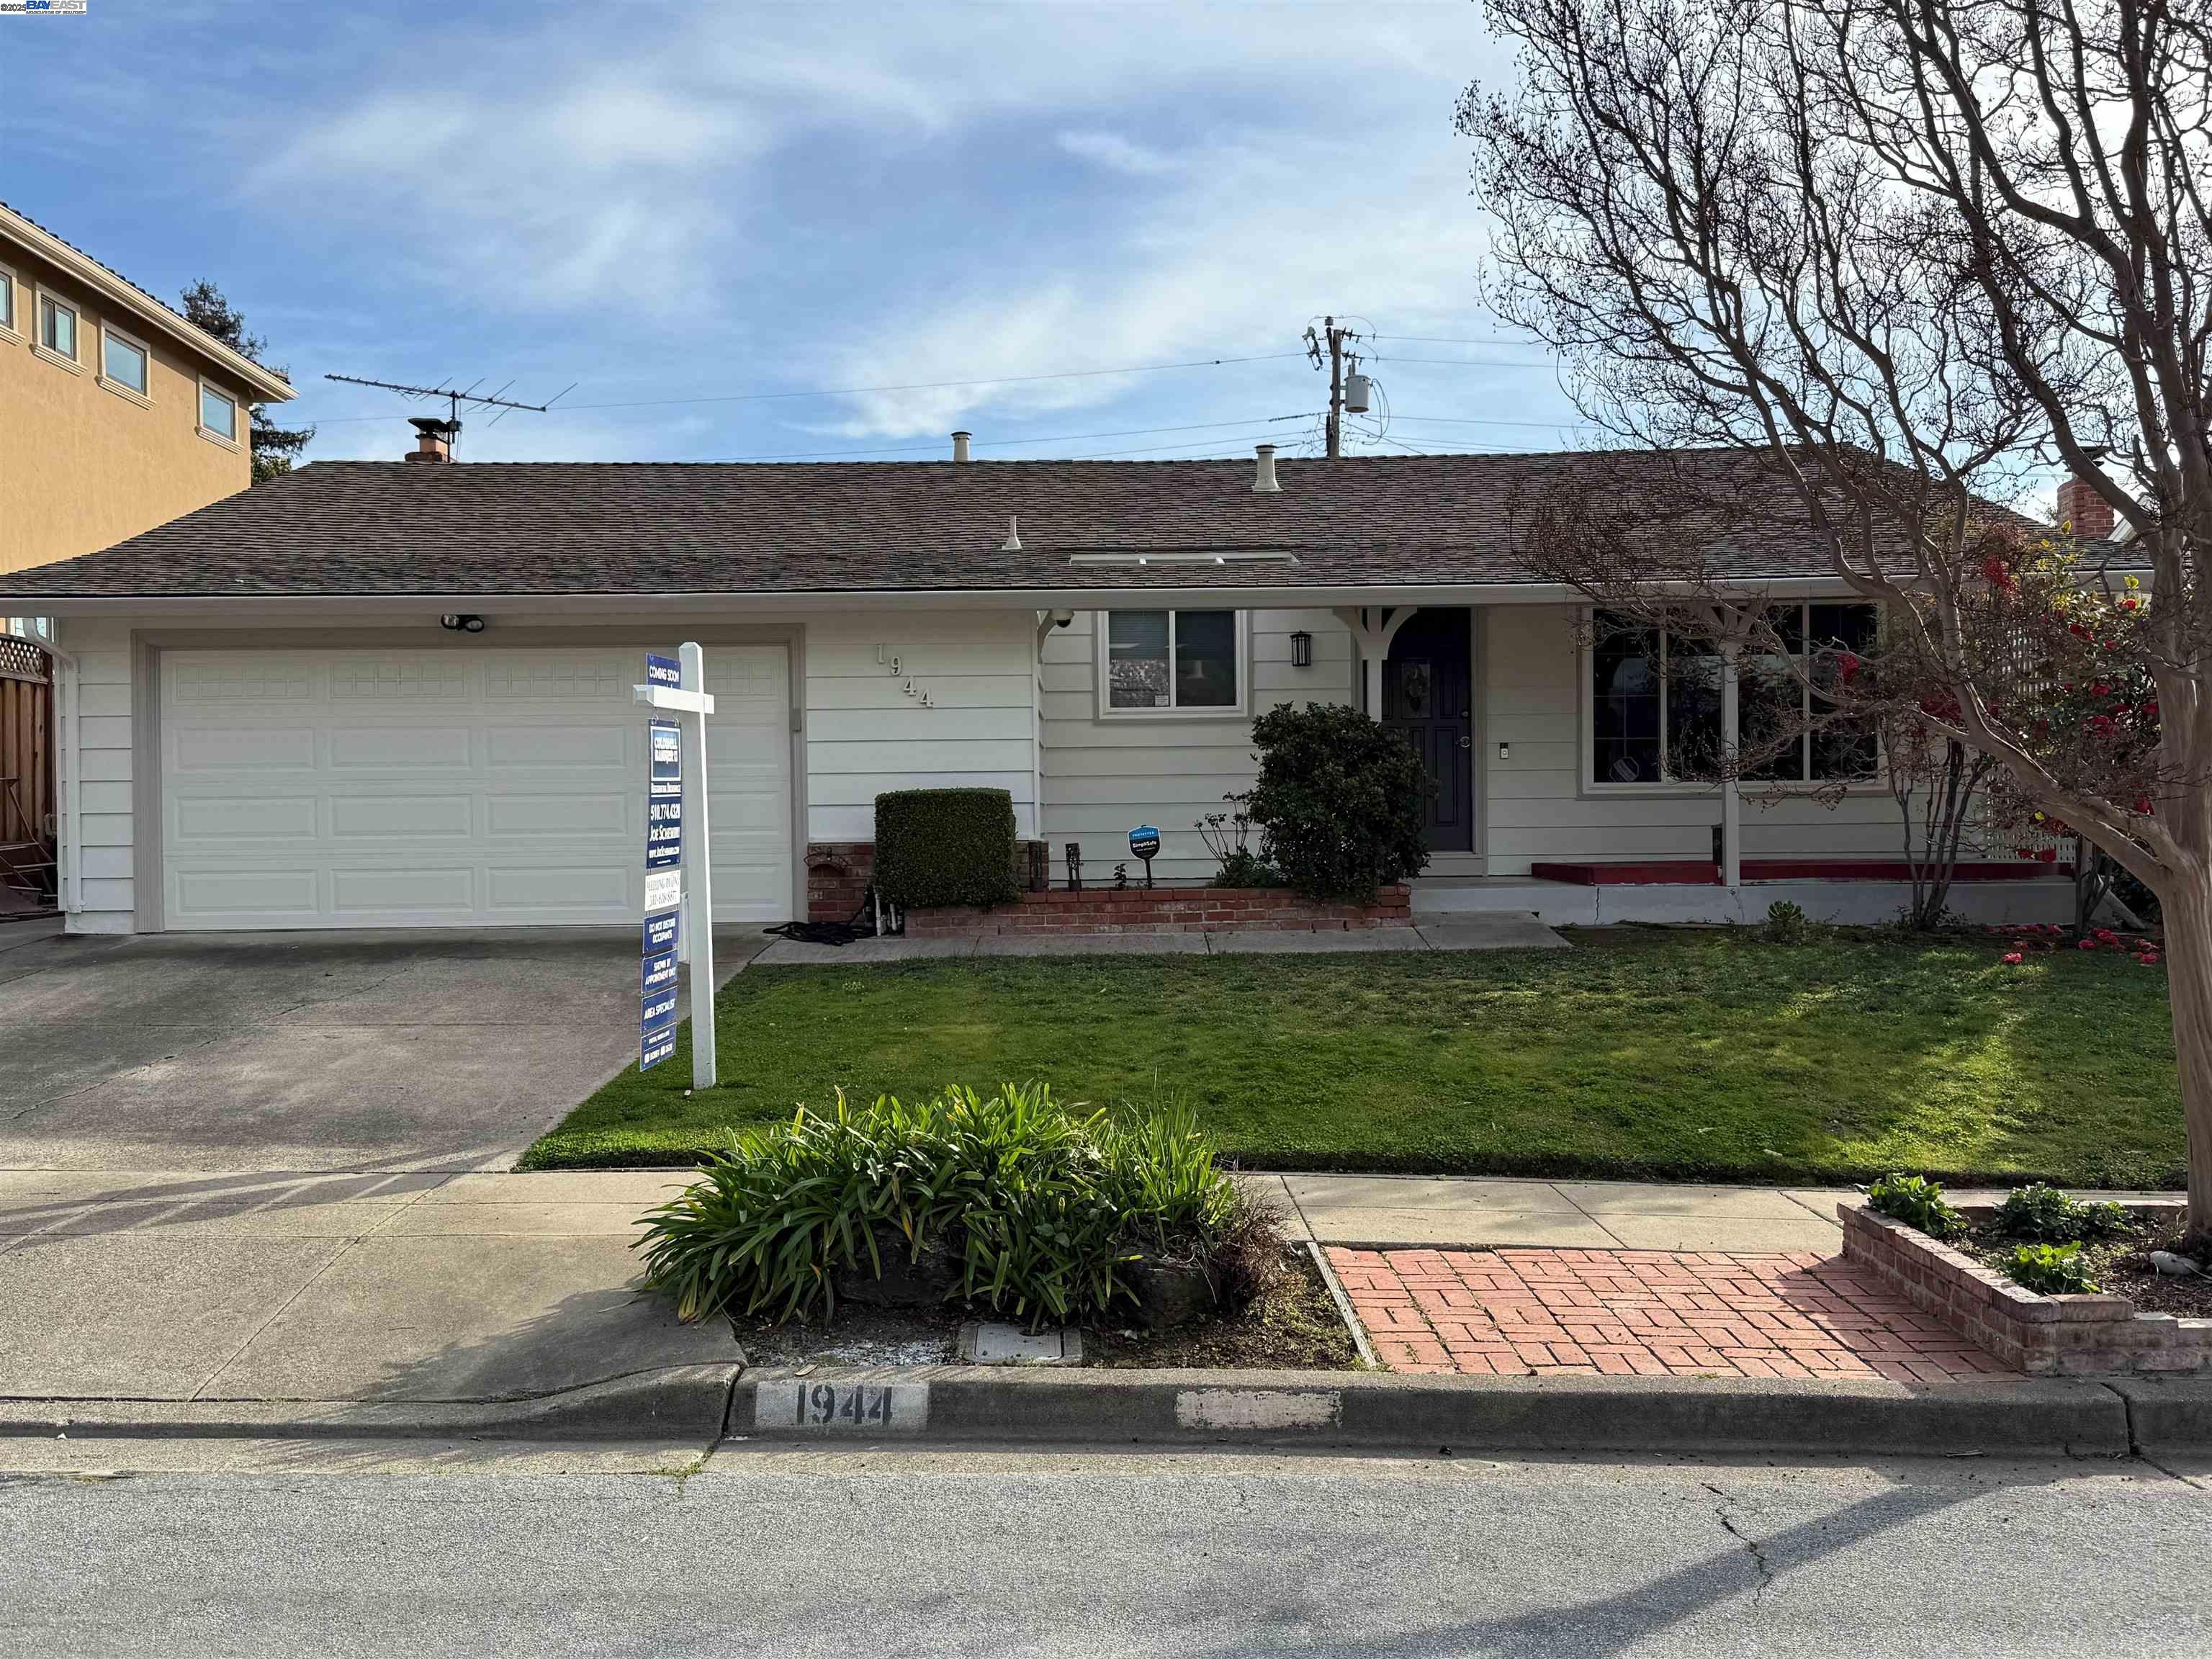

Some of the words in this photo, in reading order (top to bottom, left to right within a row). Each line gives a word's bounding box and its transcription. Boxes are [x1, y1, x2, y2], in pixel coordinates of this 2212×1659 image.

[649, 665, 667, 680] COMING
[667, 669, 680, 682] SOON
[876, 644, 934, 708] 1944
[644, 1007, 655, 1020] AREA
[655, 998, 675, 1015] SPECIALIST
[796, 1385, 893, 1424] 1944
